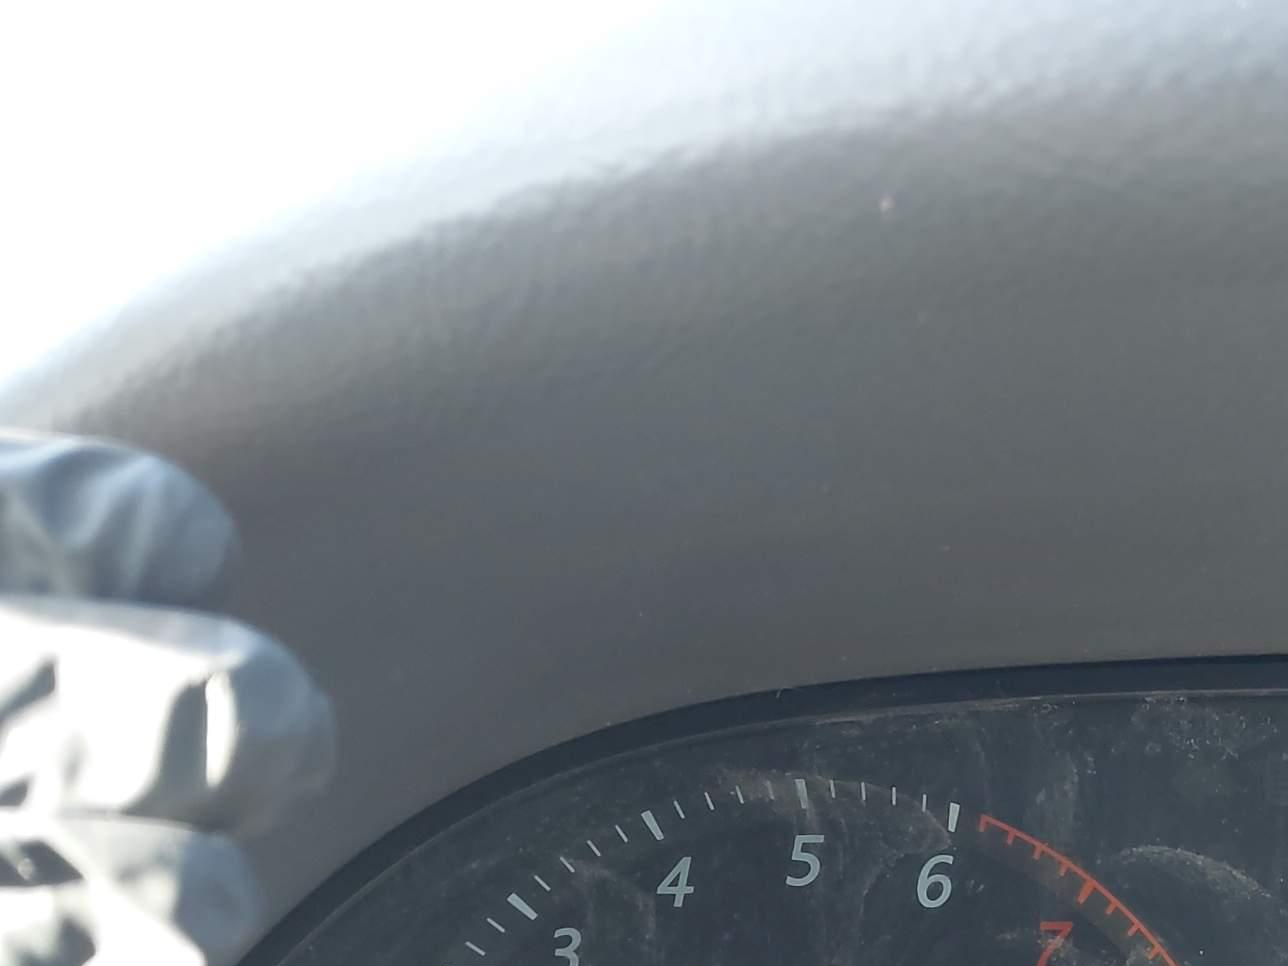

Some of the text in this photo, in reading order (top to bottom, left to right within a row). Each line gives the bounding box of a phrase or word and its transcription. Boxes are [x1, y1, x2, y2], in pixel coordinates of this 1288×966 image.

[656, 856, 694, 908] 4
[785, 835, 825, 887] 5
[916, 855, 954, 909] 6
